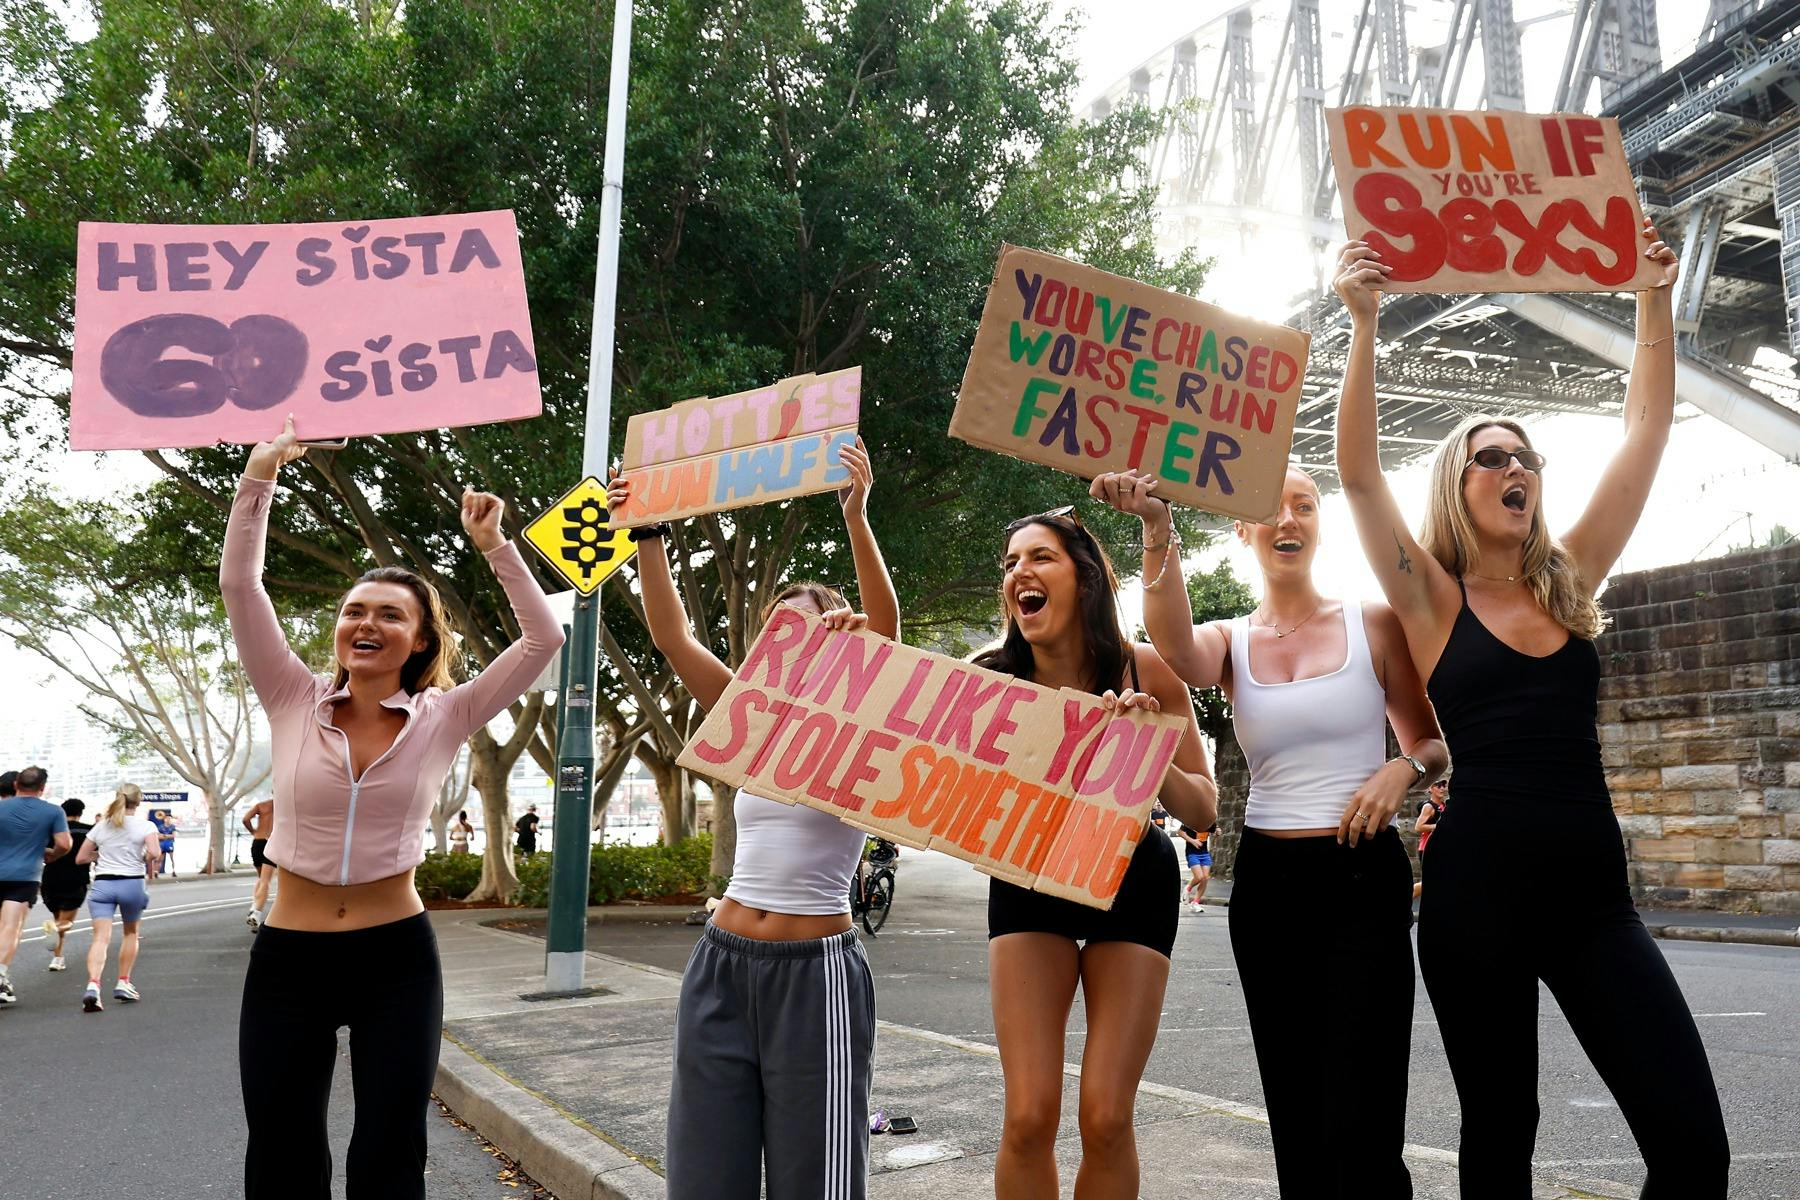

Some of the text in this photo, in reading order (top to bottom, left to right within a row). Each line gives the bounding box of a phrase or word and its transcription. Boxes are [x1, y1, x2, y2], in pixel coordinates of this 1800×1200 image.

[1343, 109, 1604, 176] RUN IF
[1432, 173, 1543, 197] YOU'RE
[97, 240, 270, 291] HEY
[1009, 321, 1277, 434] WORSE. RUN
[1152, 317, 1298, 393] CHASED
[618, 432, 858, 521] RUN HALF'S
[1011, 378, 1242, 495] FASTER
[738, 608, 1180, 807] RUN LIKE YOU
[692, 688, 1142, 900] STOLE SOMETHING
